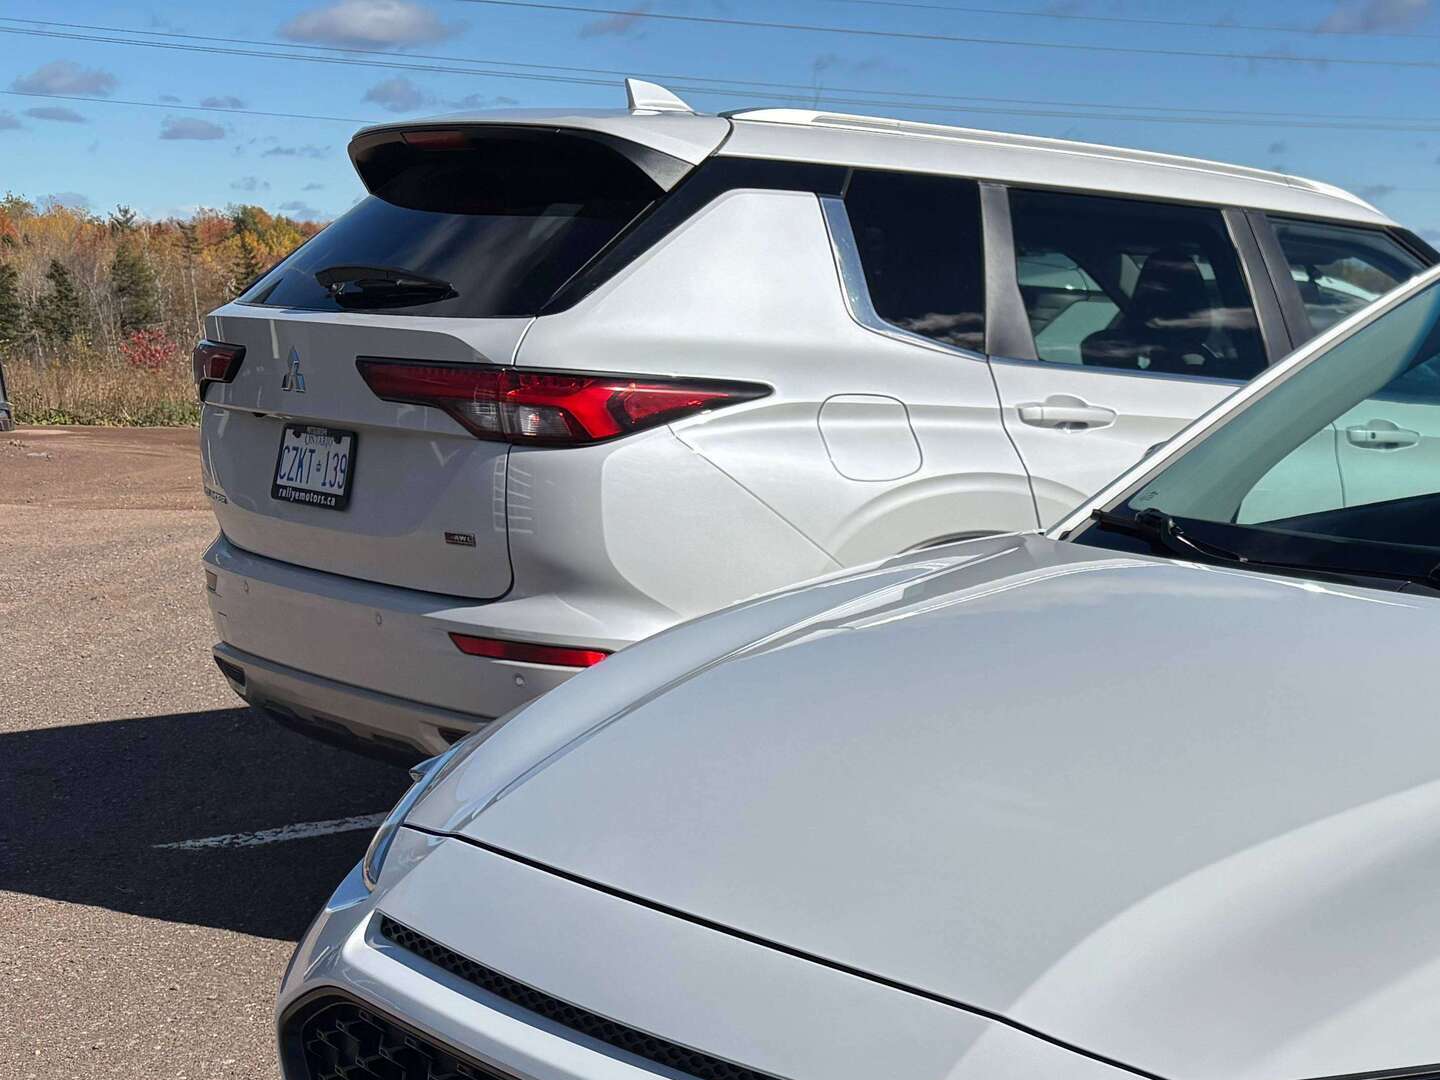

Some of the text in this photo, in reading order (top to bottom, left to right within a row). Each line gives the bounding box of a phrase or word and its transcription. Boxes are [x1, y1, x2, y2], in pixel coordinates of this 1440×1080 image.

[279, 445, 348, 489] CZKT 139
[278, 486, 336, 506] rallyemotors.ca
